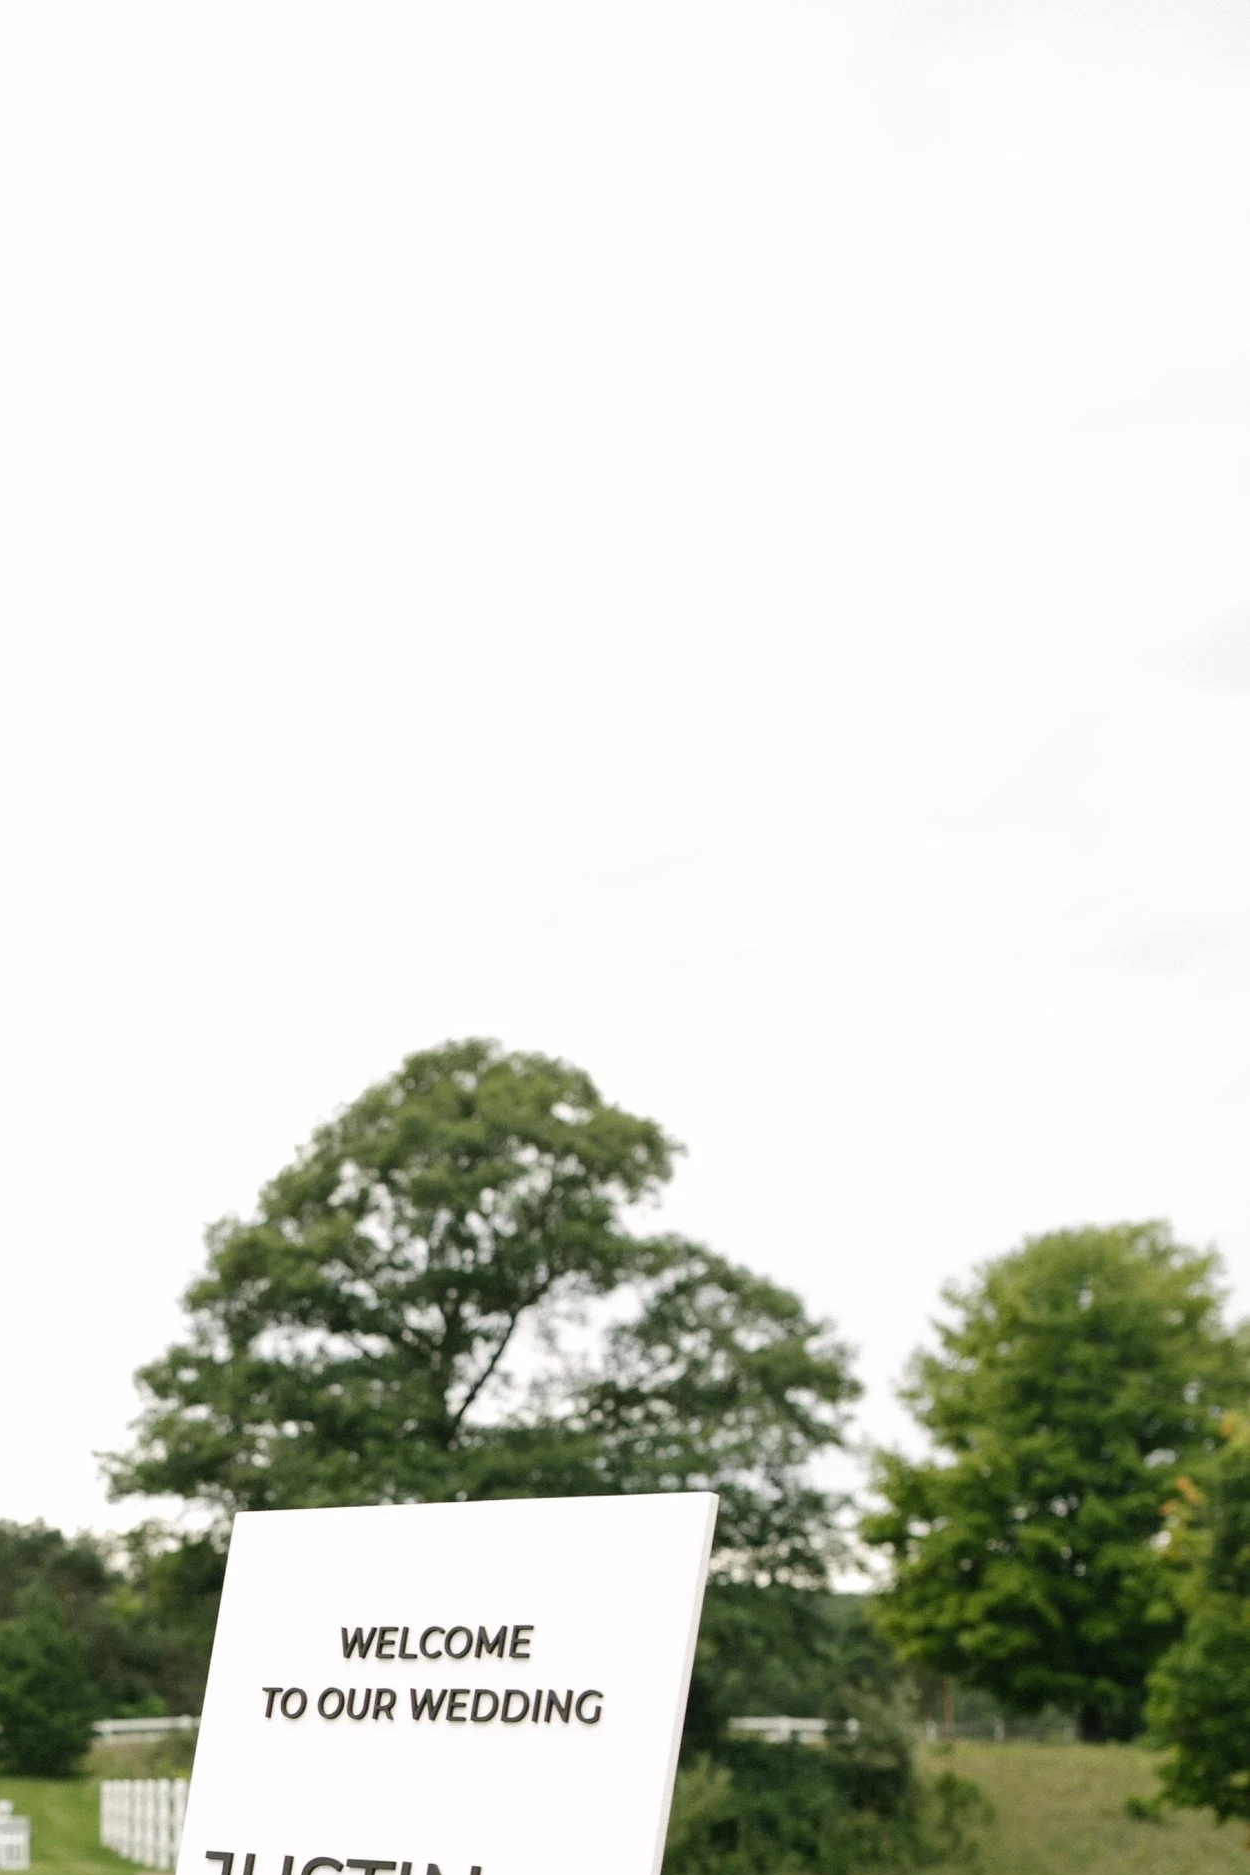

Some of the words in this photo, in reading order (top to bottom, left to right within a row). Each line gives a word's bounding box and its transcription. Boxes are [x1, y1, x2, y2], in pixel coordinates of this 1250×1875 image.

[341, 1624, 535, 1660] WELCOME
[261, 1687, 308, 1720] TO
[317, 1686, 398, 1721] OUR
[409, 1688, 604, 1725] WEDDING
